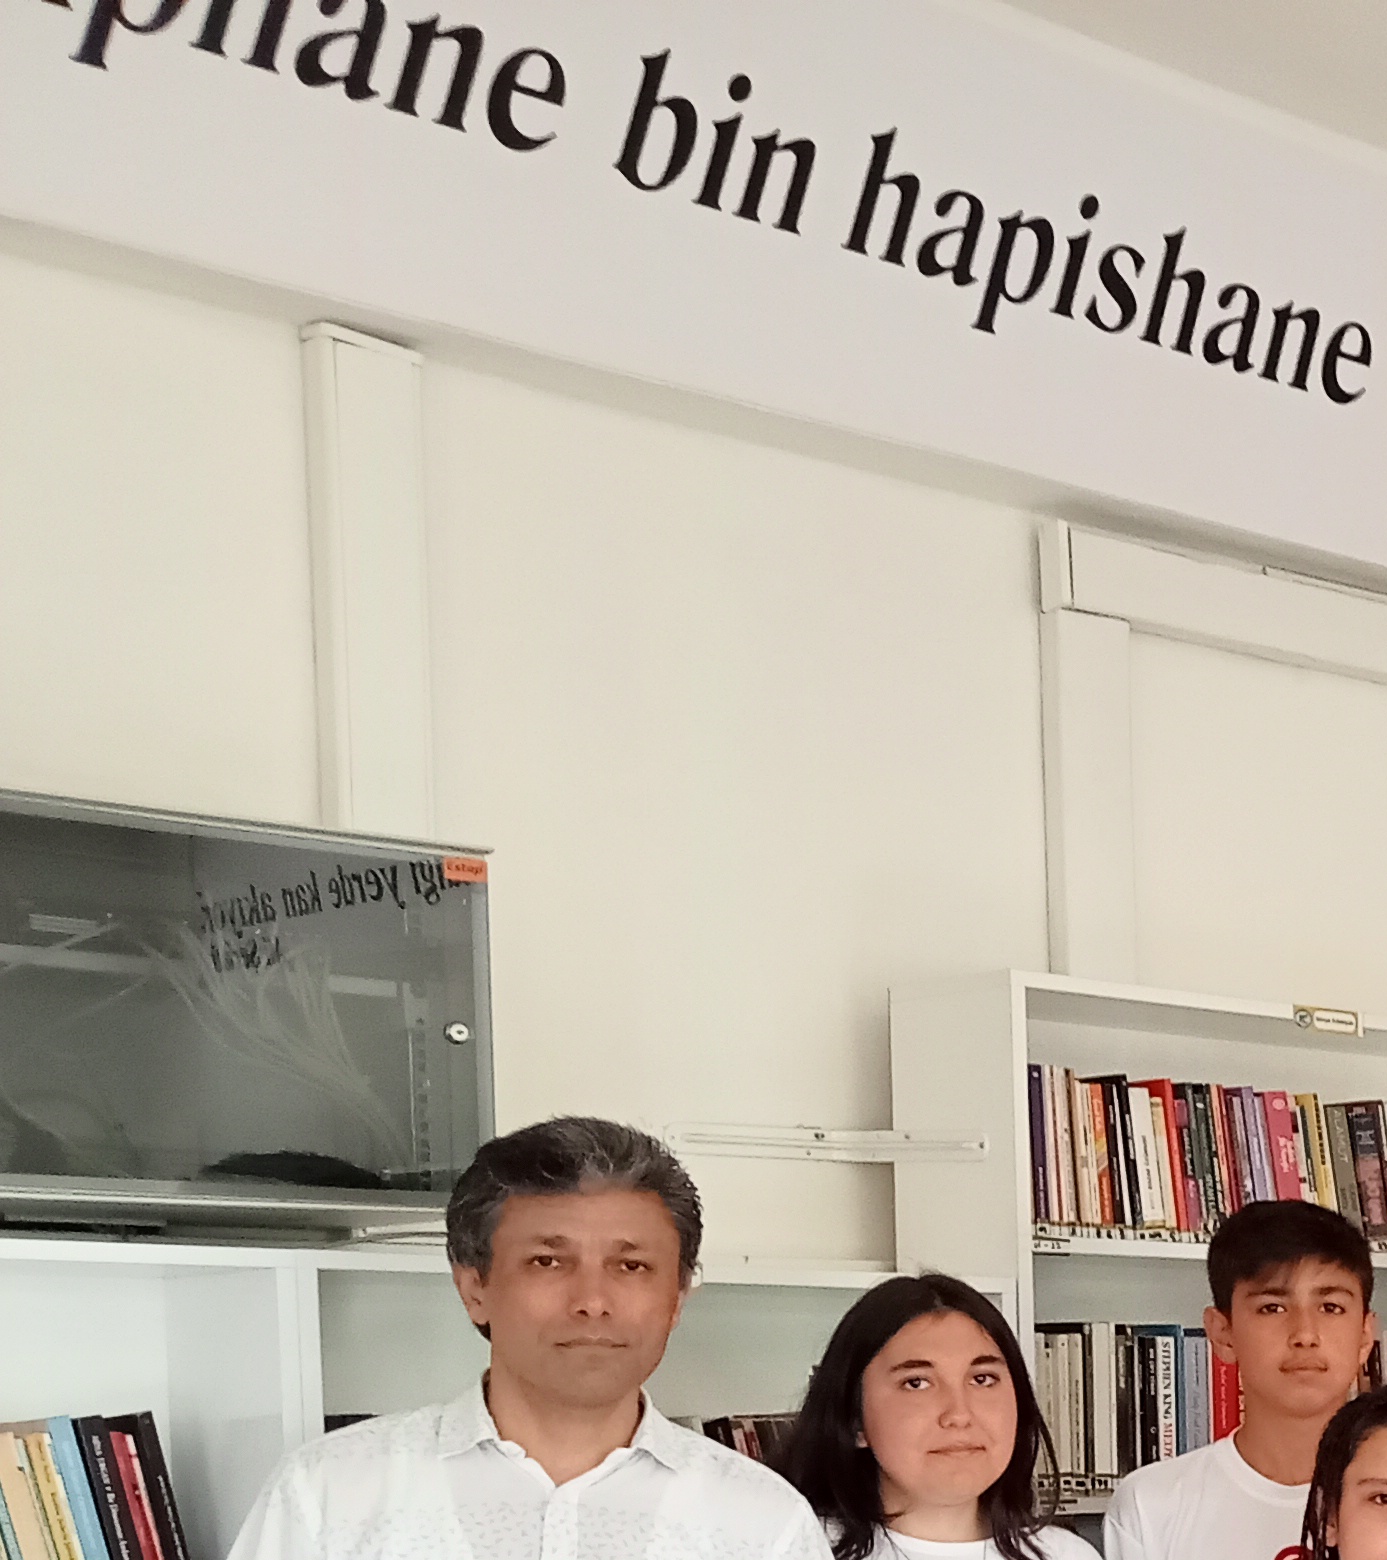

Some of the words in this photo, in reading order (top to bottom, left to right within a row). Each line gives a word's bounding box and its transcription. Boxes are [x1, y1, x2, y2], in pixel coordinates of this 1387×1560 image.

[612, 47, 817, 236] bin
[841, 126, 1373, 404] hapishane
[1332, 1108, 1349, 1164] ALAMUT
[1161, 1340, 1173, 1390] STEPHEN
[1162, 1393, 1173, 1420] KING
